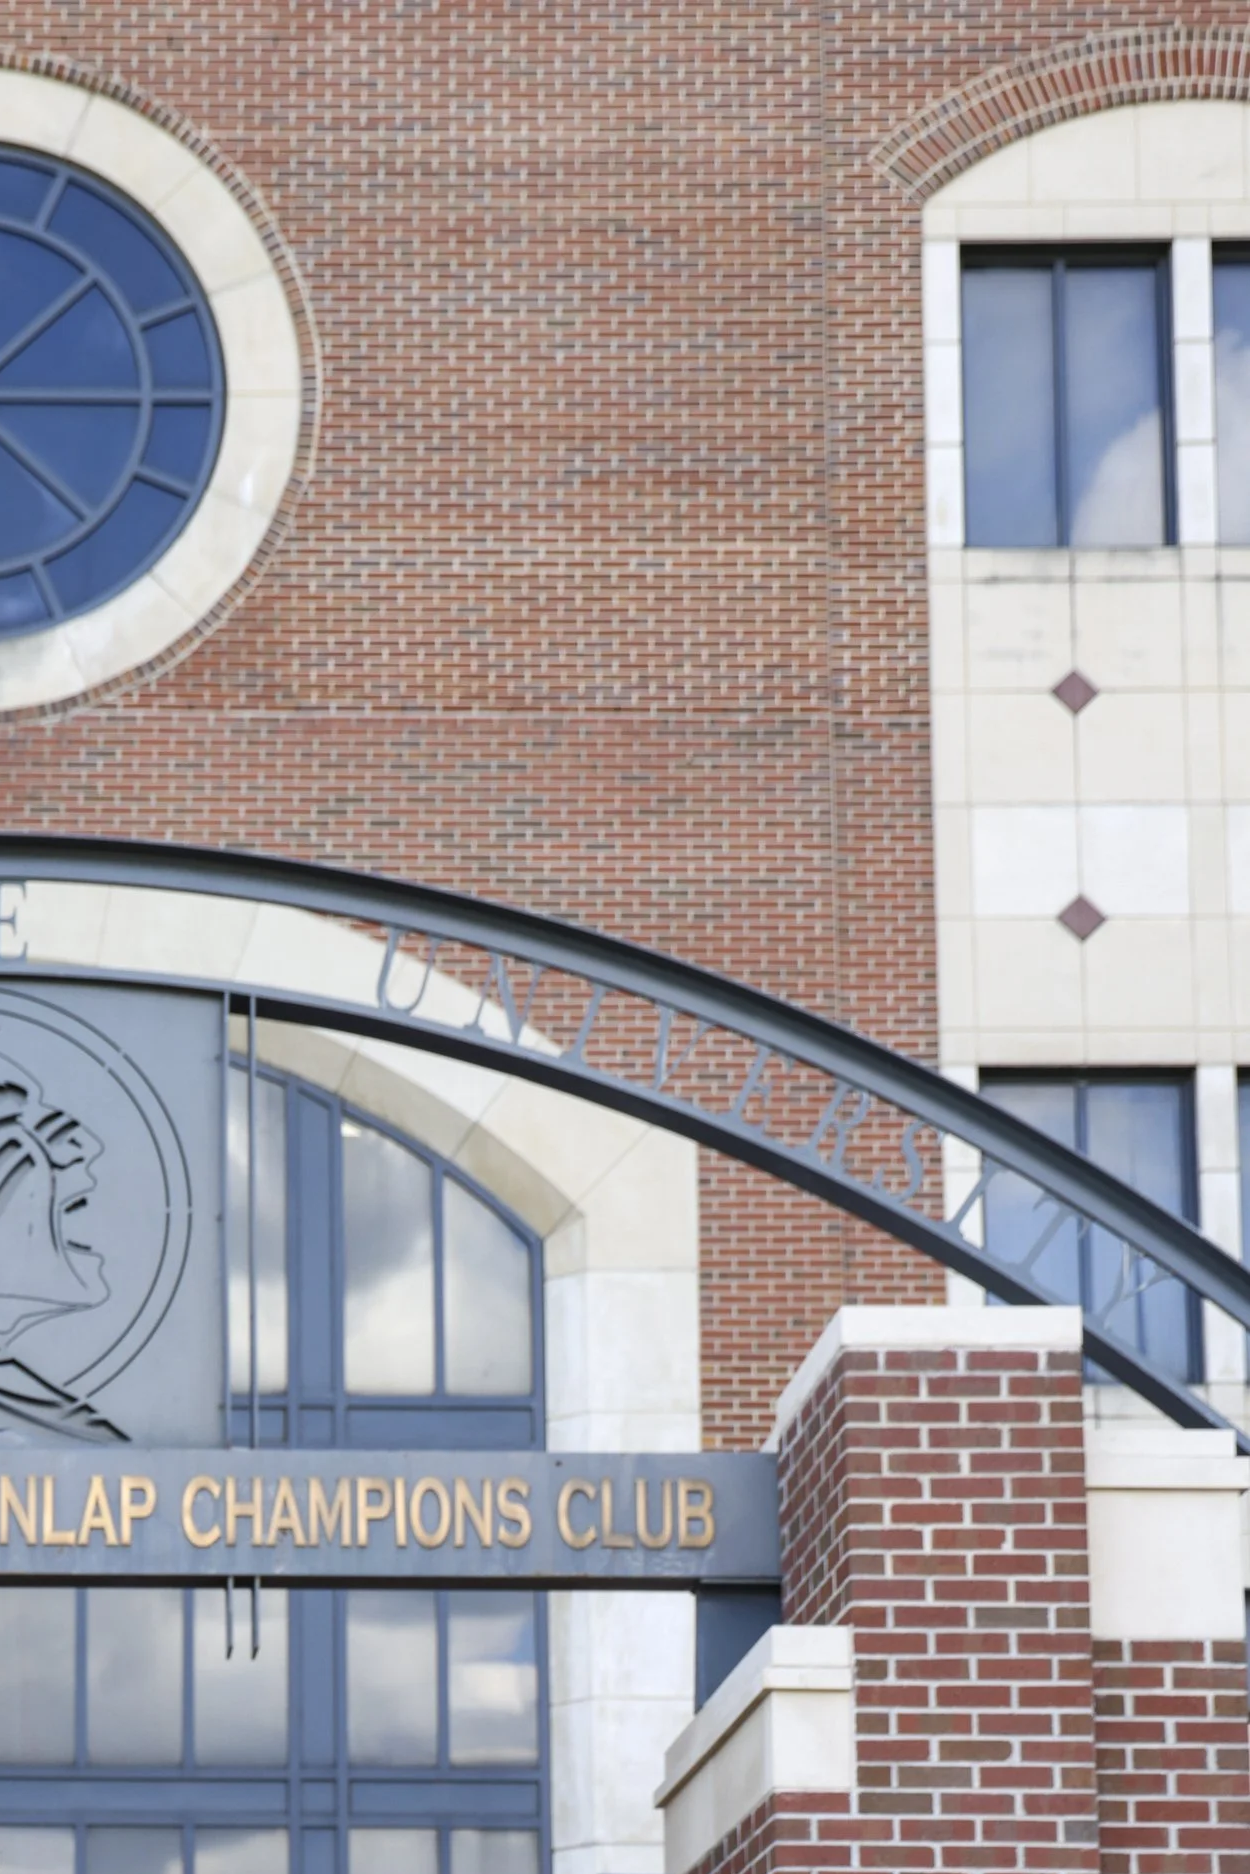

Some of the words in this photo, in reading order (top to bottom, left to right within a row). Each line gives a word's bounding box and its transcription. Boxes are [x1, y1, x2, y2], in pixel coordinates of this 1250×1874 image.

[376, 926, 1178, 1332] UNIVERSITY
[180, 1475, 533, 1549] CHAMPIONS
[556, 1478, 717, 1549] CLUB
